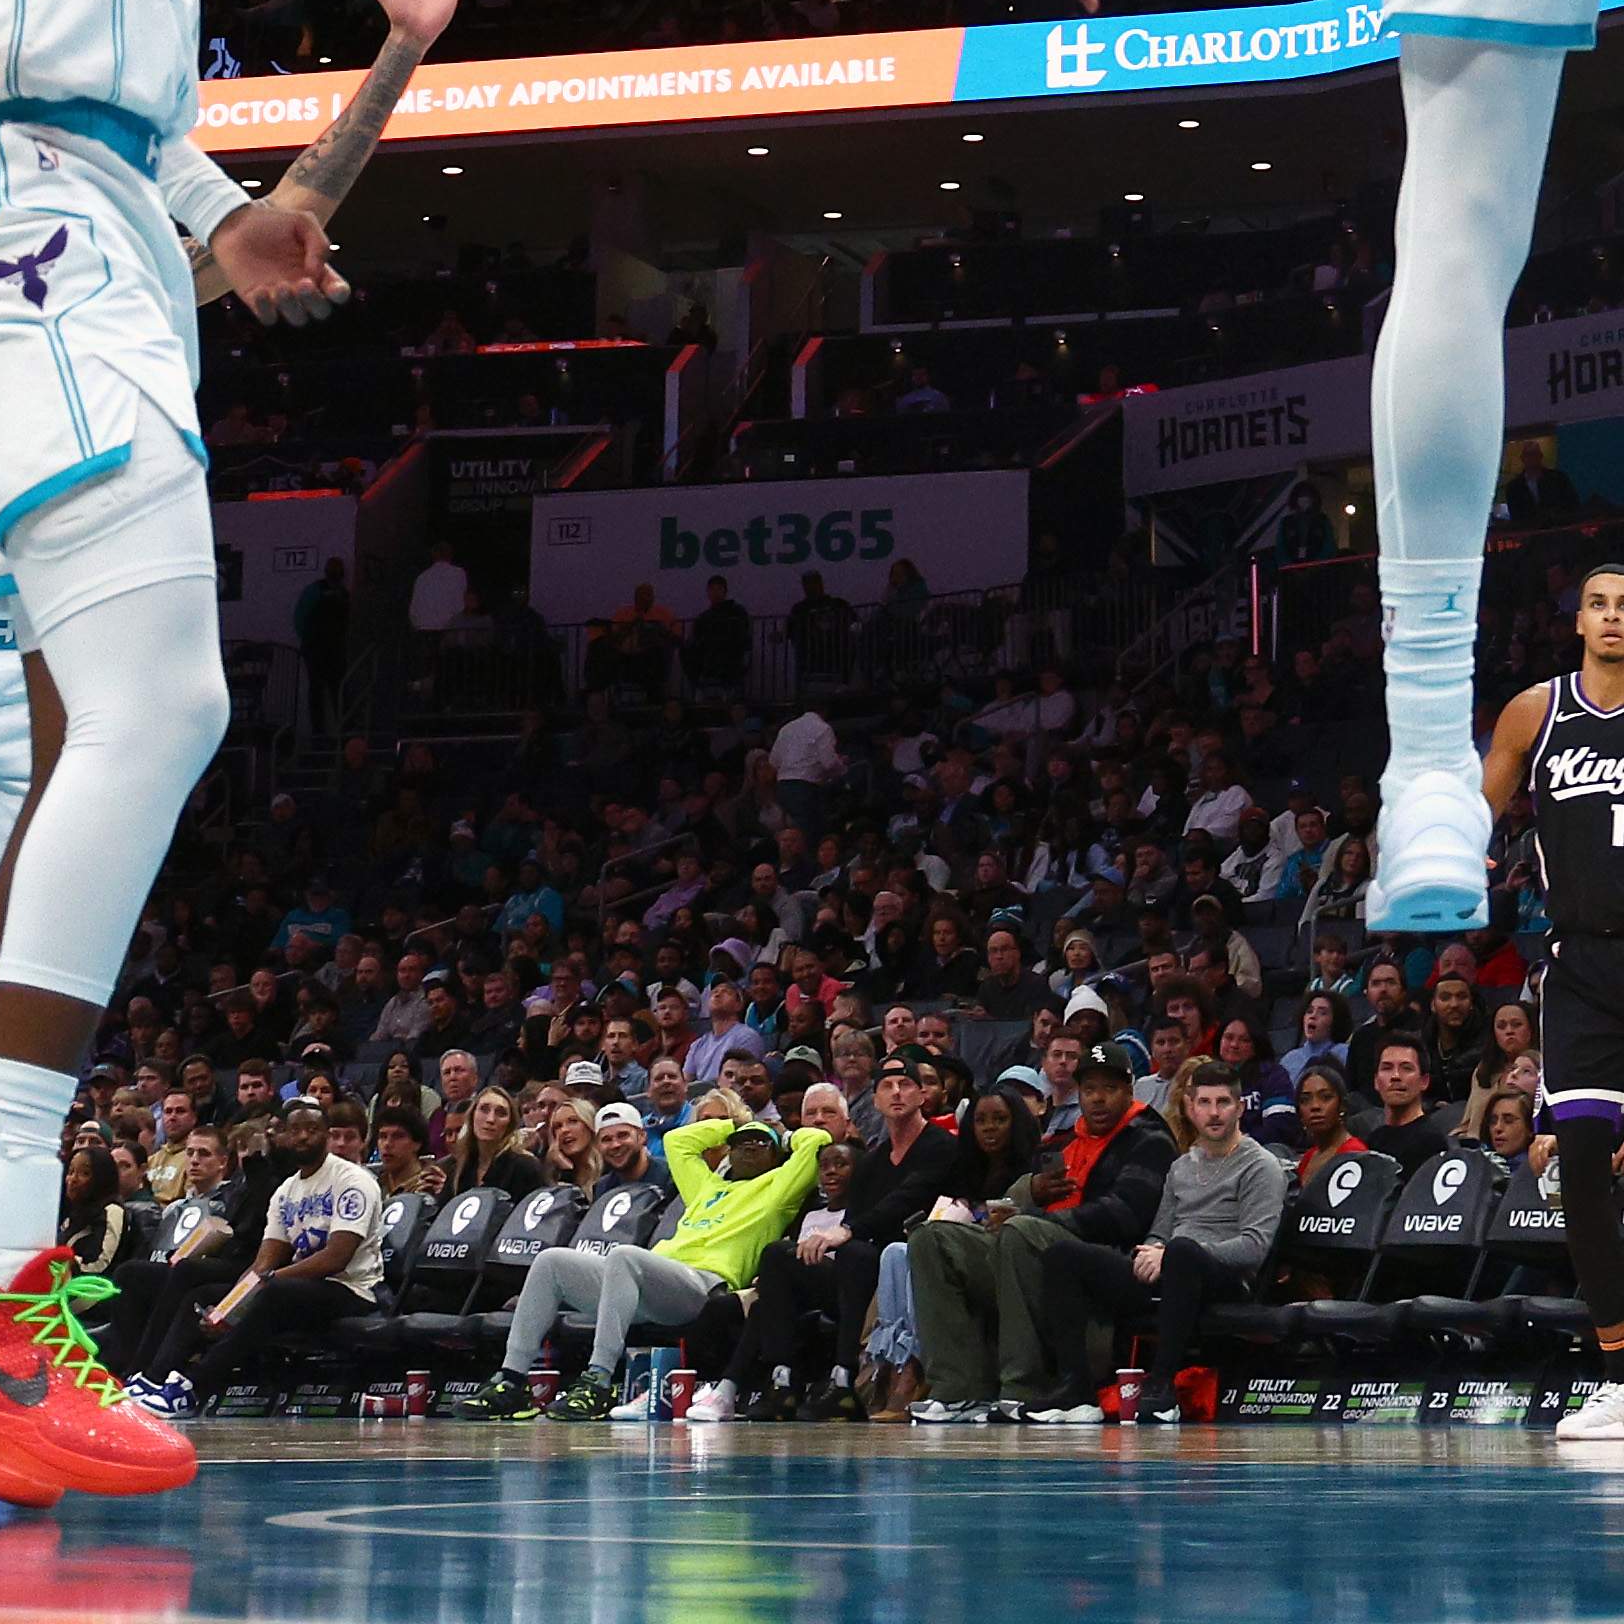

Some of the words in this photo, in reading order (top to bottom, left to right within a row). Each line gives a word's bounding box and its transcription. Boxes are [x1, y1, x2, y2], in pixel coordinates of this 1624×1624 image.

[1114, 15, 1341, 71] CHARLOTTE
[511, 66, 732, 110] APPOINTMENTS
[741, 55, 896, 91] AVAILABLE
[1184, 387, 1279, 417] CHARLOTTE
[1156, 396, 1311, 469] HORNETS
[451, 458, 532, 478] UTILITY
[659, 509, 895, 571] bet365
[1298, 1214, 1355, 1235] wave
[1403, 1213, 1462, 1233] wave
[426, 1243, 470, 1259] wave
[498, 1240, 541, 1255] wave
[226, 1385, 259, 1396] UTILITY
[369, 1382, 405, 1394] UTILITY
[444, 1381, 481, 1394] UTILITY
[1221, 1388, 1238, 1405] 21
[1247, 1377, 1296, 1392] UTILITY
[1321, 1394, 1342, 1410] 22
[1350, 1382, 1400, 1396] UTILITY
[1428, 1392, 1449, 1409] 23
[1458, 1381, 1509, 1395] UTILITY
[1257, 1392, 1318, 1404] INNOVATION
[1361, 1395, 1422, 1408] INNOVATION
[1540, 1392, 1561, 1409] 24
[1238, 1404, 1272, 1415] GROUP
